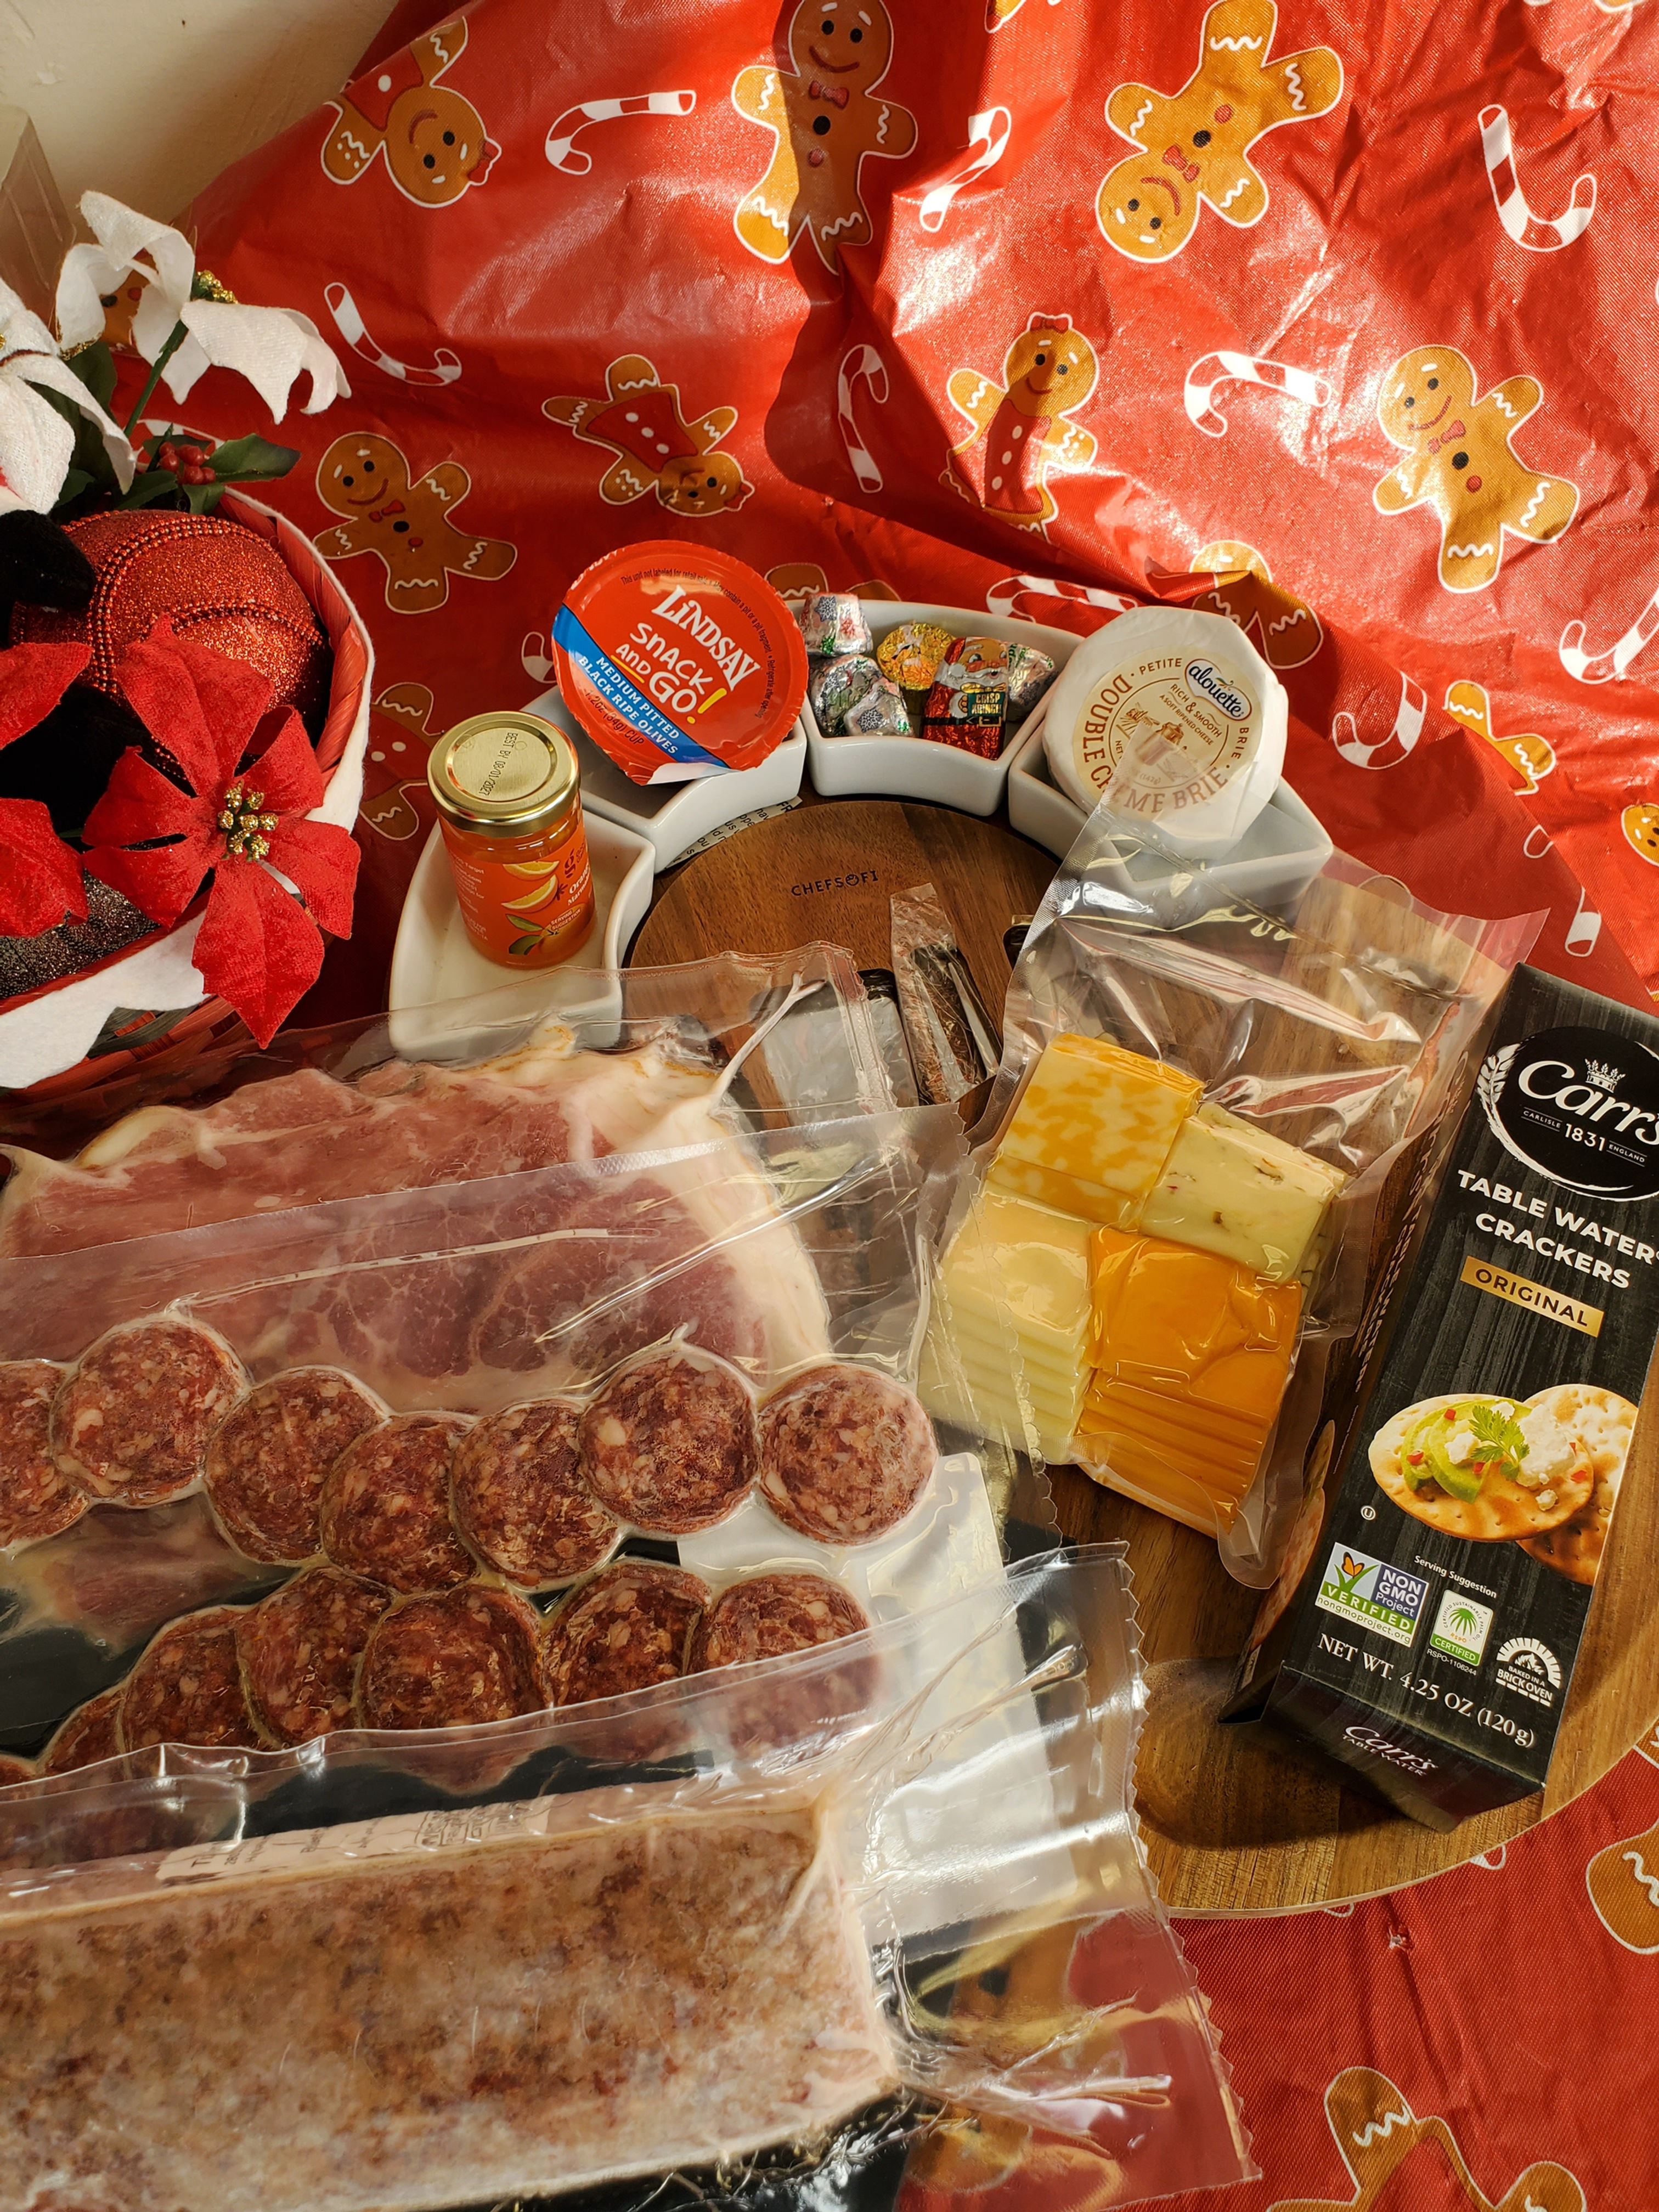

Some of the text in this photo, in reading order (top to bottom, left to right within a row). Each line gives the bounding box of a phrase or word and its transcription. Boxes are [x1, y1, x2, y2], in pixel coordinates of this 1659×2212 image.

[620, 575, 632, 585] This
[724, 589, 741, 605] contain
[1138, 658, 1183, 675] PETITE
[578, 656, 678, 754] BLACK RIPE OLIVES
[596, 657, 680, 739] MEDIUM PITTED
[976, 693, 1000, 703] CRISP
[1189, 665, 1242, 717] alouette
[1163, 697, 1177, 710] SOFT
[1175, 709, 1196, 729] RIPENED
[1194, 726, 1215, 746] CHEESE
[1171, 684, 1222, 738] RICH & SMOOTH
[503, 732, 518, 748] BEST
[624, 730, 645, 744] CUP
[1082, 674, 1133, 763] DOUBLE
[1172, 766, 1228, 810] BRIE
[1115, 741, 1124, 754] NET
[1231, 727, 1249, 759] BRIE
[498, 750, 511, 759] BY
[791, 870, 878, 896] CHEFSOFI
[551, 910, 573, 925] SERVING
[552, 908, 581, 930] SUGGESTION
[1523, 1110, 1645, 1163] CARLISLE 1831 ENGLAND
[1458, 1170, 1657, 1265] TABLE WATER
[1475, 1213, 1632, 1289] CRACKERS
[1475, 1269, 1588, 1327] ORIGINAL
[1383, 1569, 1422, 1595] NON
[1414, 1555, 1497, 1599] Serving Suggestion
[1328, 1585, 1410, 1630] VERIFIED
[1375, 1592, 1415, 1617] Project
[1378, 1581, 1419, 1606] GMO
[1318, 1597, 1412, 1645] nongmoproject.org
[1426, 1648, 1477, 1676] RSPO-1106244
[1435, 1638, 1476, 1661] CERTIFIED
[1317, 1633, 1358, 1662] NET
[1362, 1652, 1394, 1680] WT.
[1400, 1672, 1440, 1701] 4.25
[1444, 1692, 1474, 1717] OZ
[1497, 1668, 1553, 1701] BRICK OVEN
[1508, 1666, 1531, 1679] BAKED
[1342, 1734, 1424, 1776] TABLE WATER
[1345, 1726, 1436, 1769] Carr's
